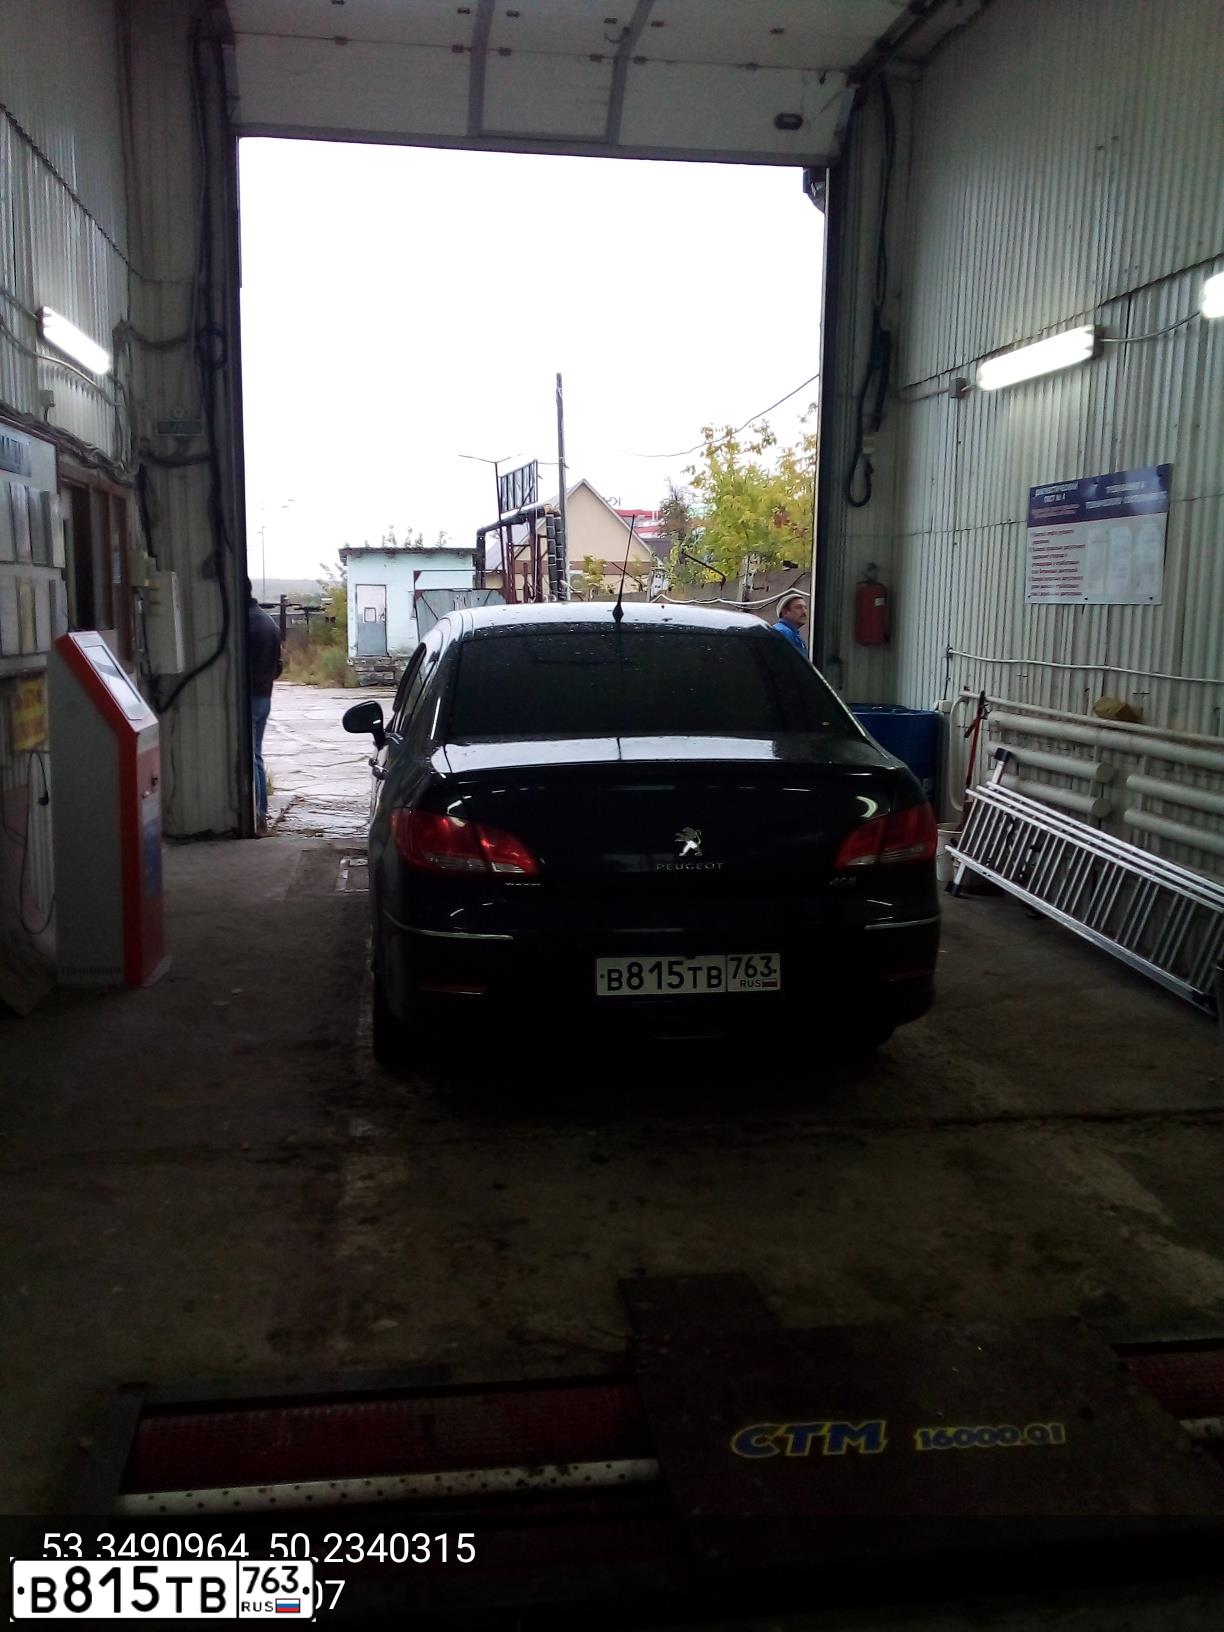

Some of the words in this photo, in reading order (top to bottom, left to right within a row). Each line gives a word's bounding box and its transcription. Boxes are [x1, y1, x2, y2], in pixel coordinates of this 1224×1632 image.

[656, 861, 724, 871] PEUGEOT
[729, 955, 773, 979] 763
[739, 979, 762, 988] RUS
[915, 1423, 1066, 1451] 16000.01
